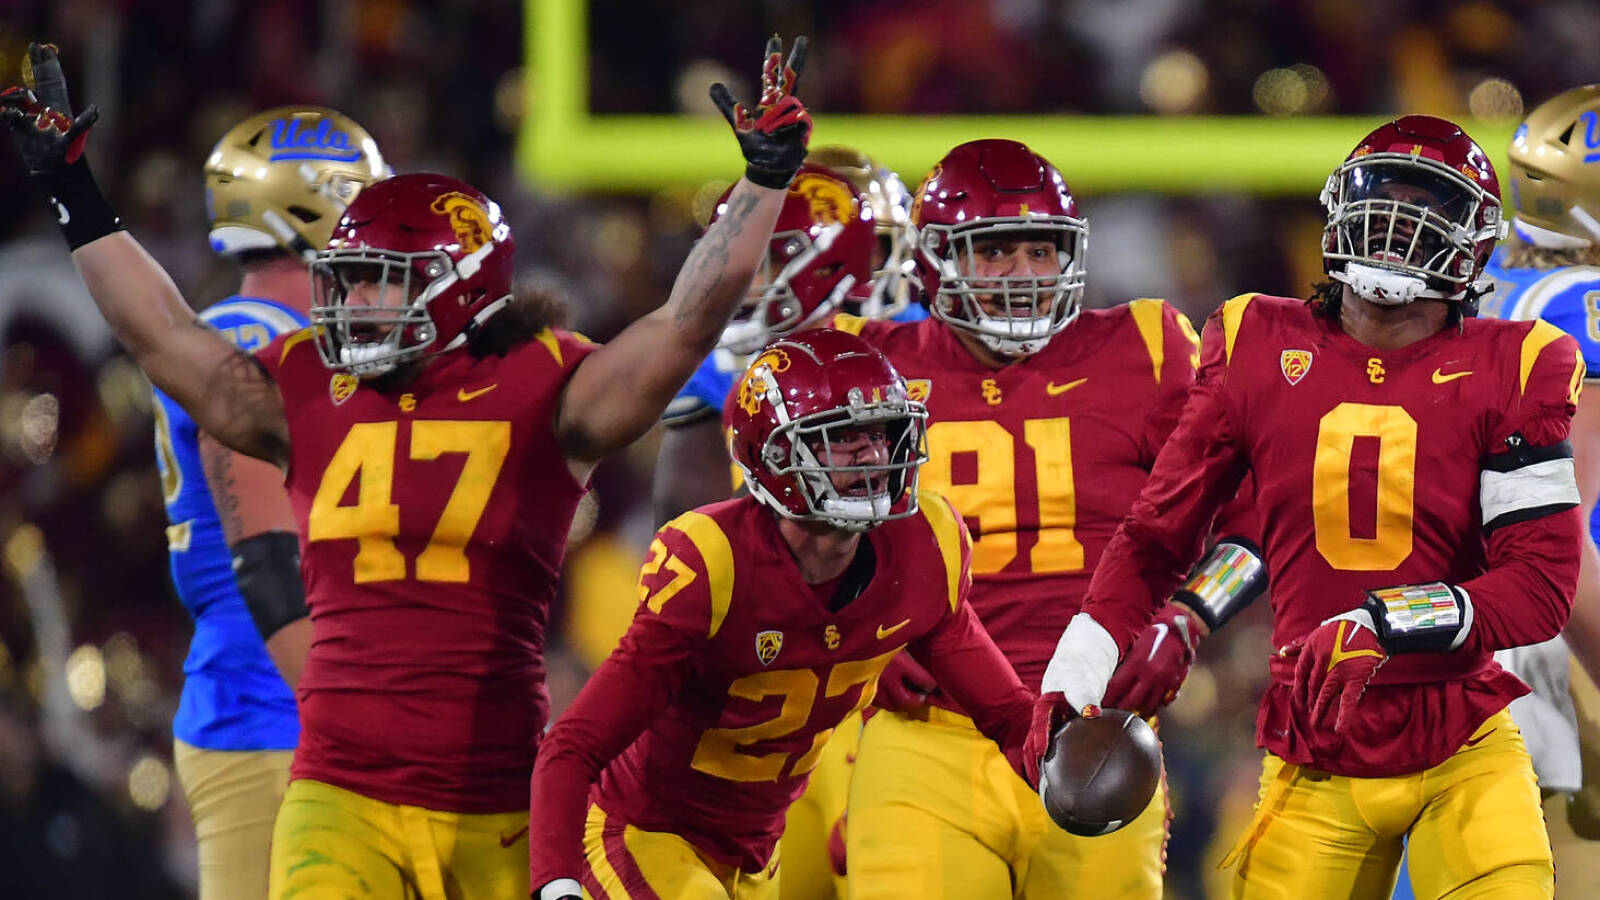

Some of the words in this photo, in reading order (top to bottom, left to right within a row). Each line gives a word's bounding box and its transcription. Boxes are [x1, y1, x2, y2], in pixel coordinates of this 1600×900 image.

[1366, 357, 1386, 384] SC
[308, 420, 512, 584] 47
[918, 416, 1085, 575] 91
[1312, 402, 1418, 571] 0
[637, 537, 698, 616] 27
[690, 642, 908, 783] 27
